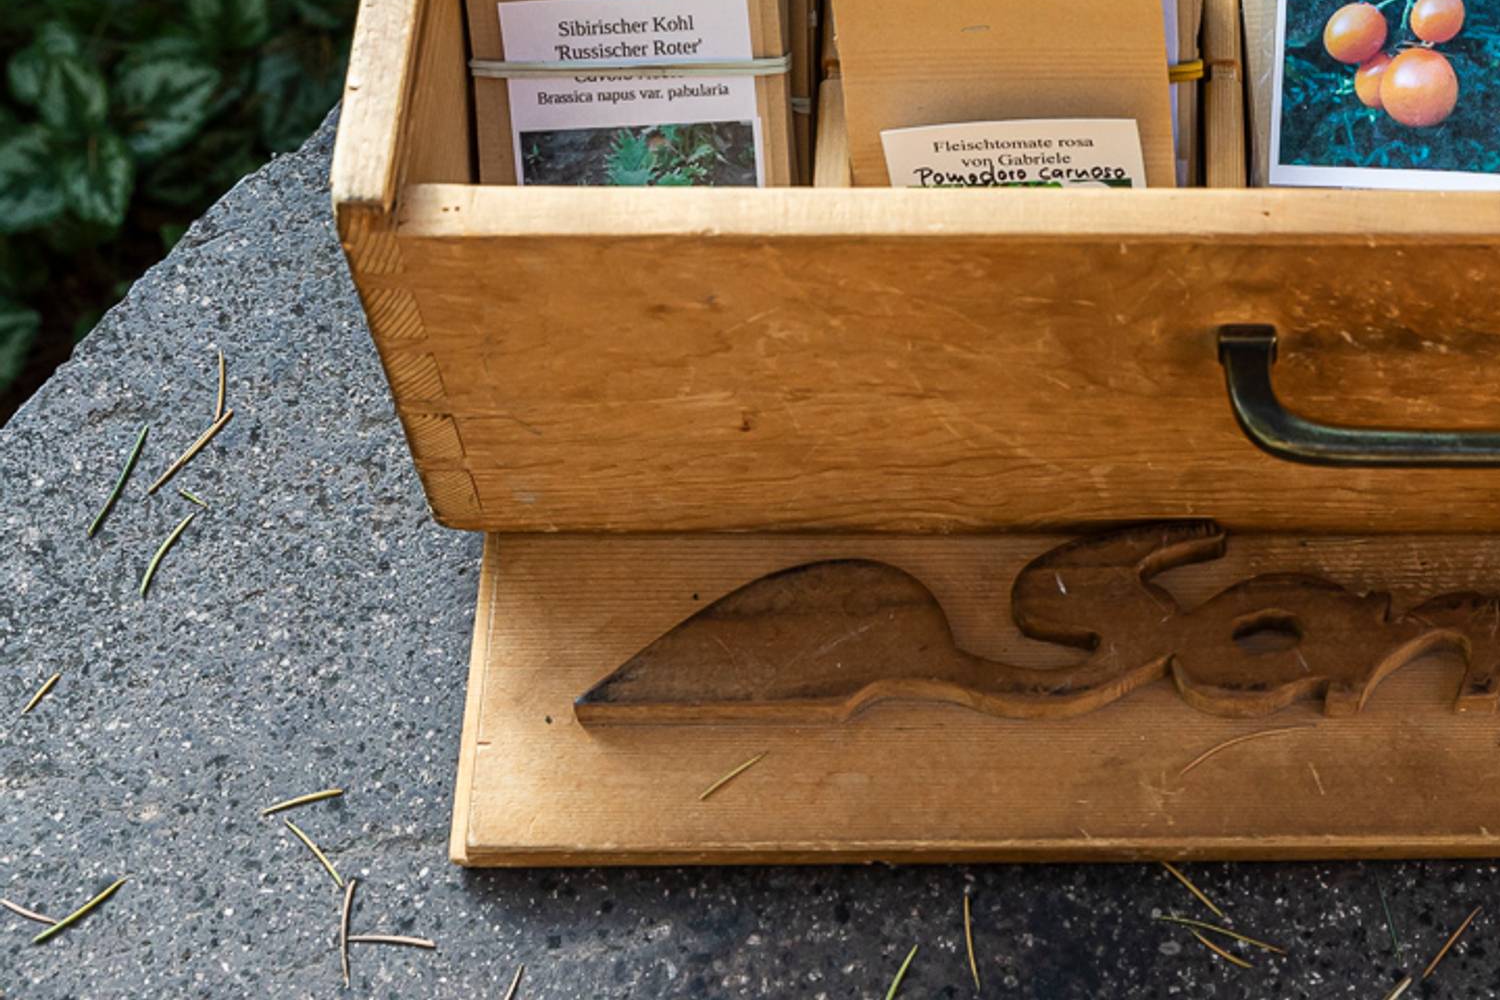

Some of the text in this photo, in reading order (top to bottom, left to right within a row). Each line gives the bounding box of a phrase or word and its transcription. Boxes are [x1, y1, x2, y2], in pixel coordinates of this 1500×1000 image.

[557, 14, 695, 38] Sibirischer Kohl
[554, 38, 703, 62] 'Russischer Roter'
[537, 84, 730, 106] Brassica napus var. pabularia
[932, 137, 1094, 154] Fleischtomate rosa
[960, 151, 1071, 169] von Gabriele
